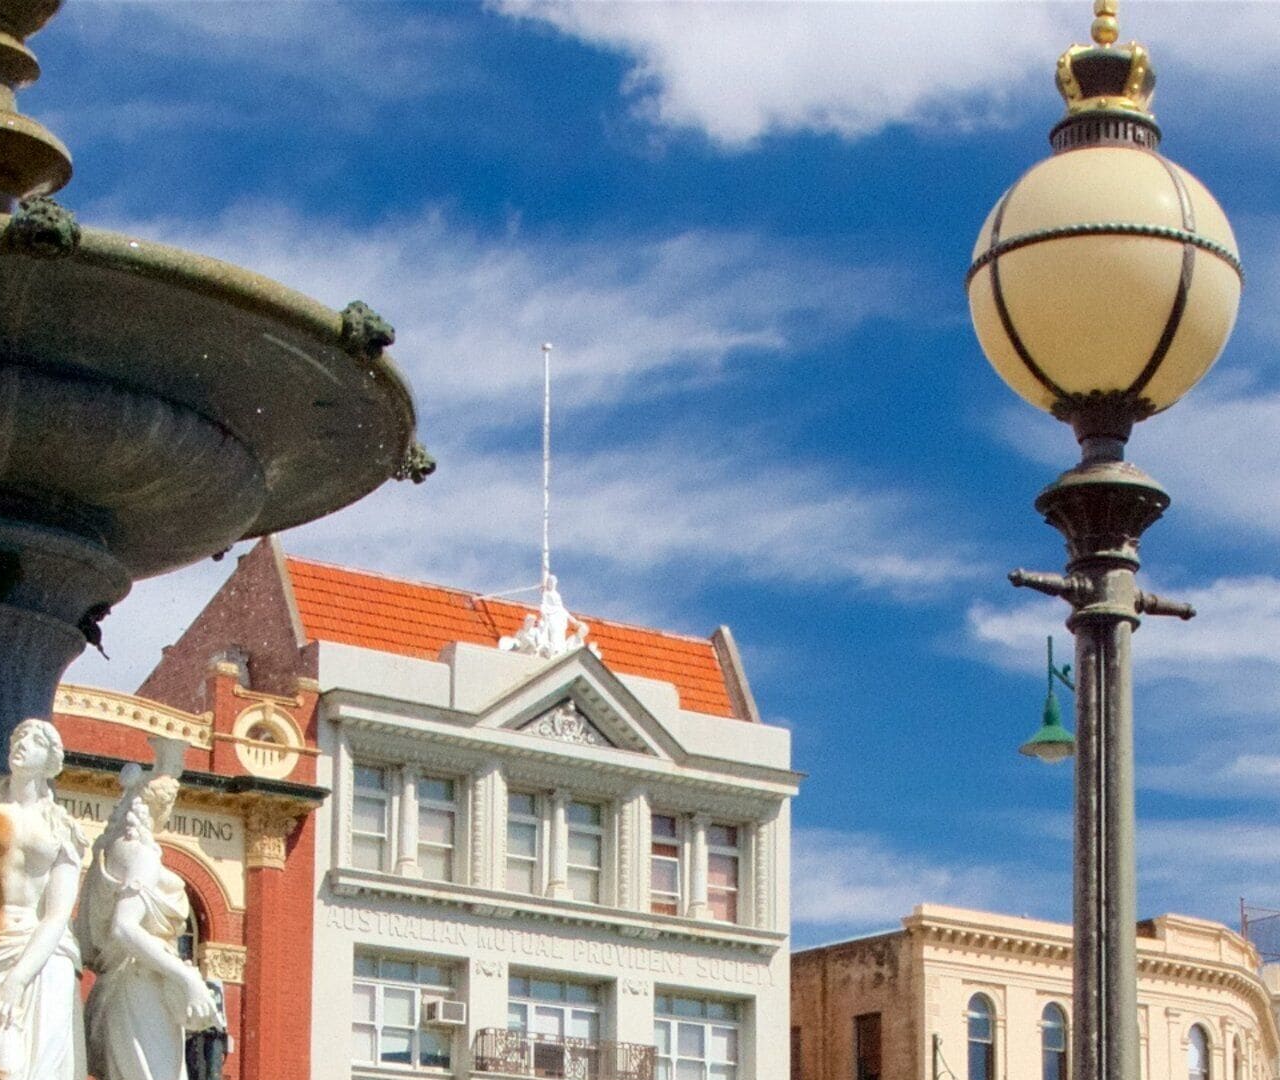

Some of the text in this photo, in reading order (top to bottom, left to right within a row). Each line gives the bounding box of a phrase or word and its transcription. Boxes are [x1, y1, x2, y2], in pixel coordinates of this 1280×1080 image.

[164, 812, 233, 842] UILDING
[326, 905, 776, 987] AUSTRALIAN MUTUAL PROVIDENT SOCIETY
